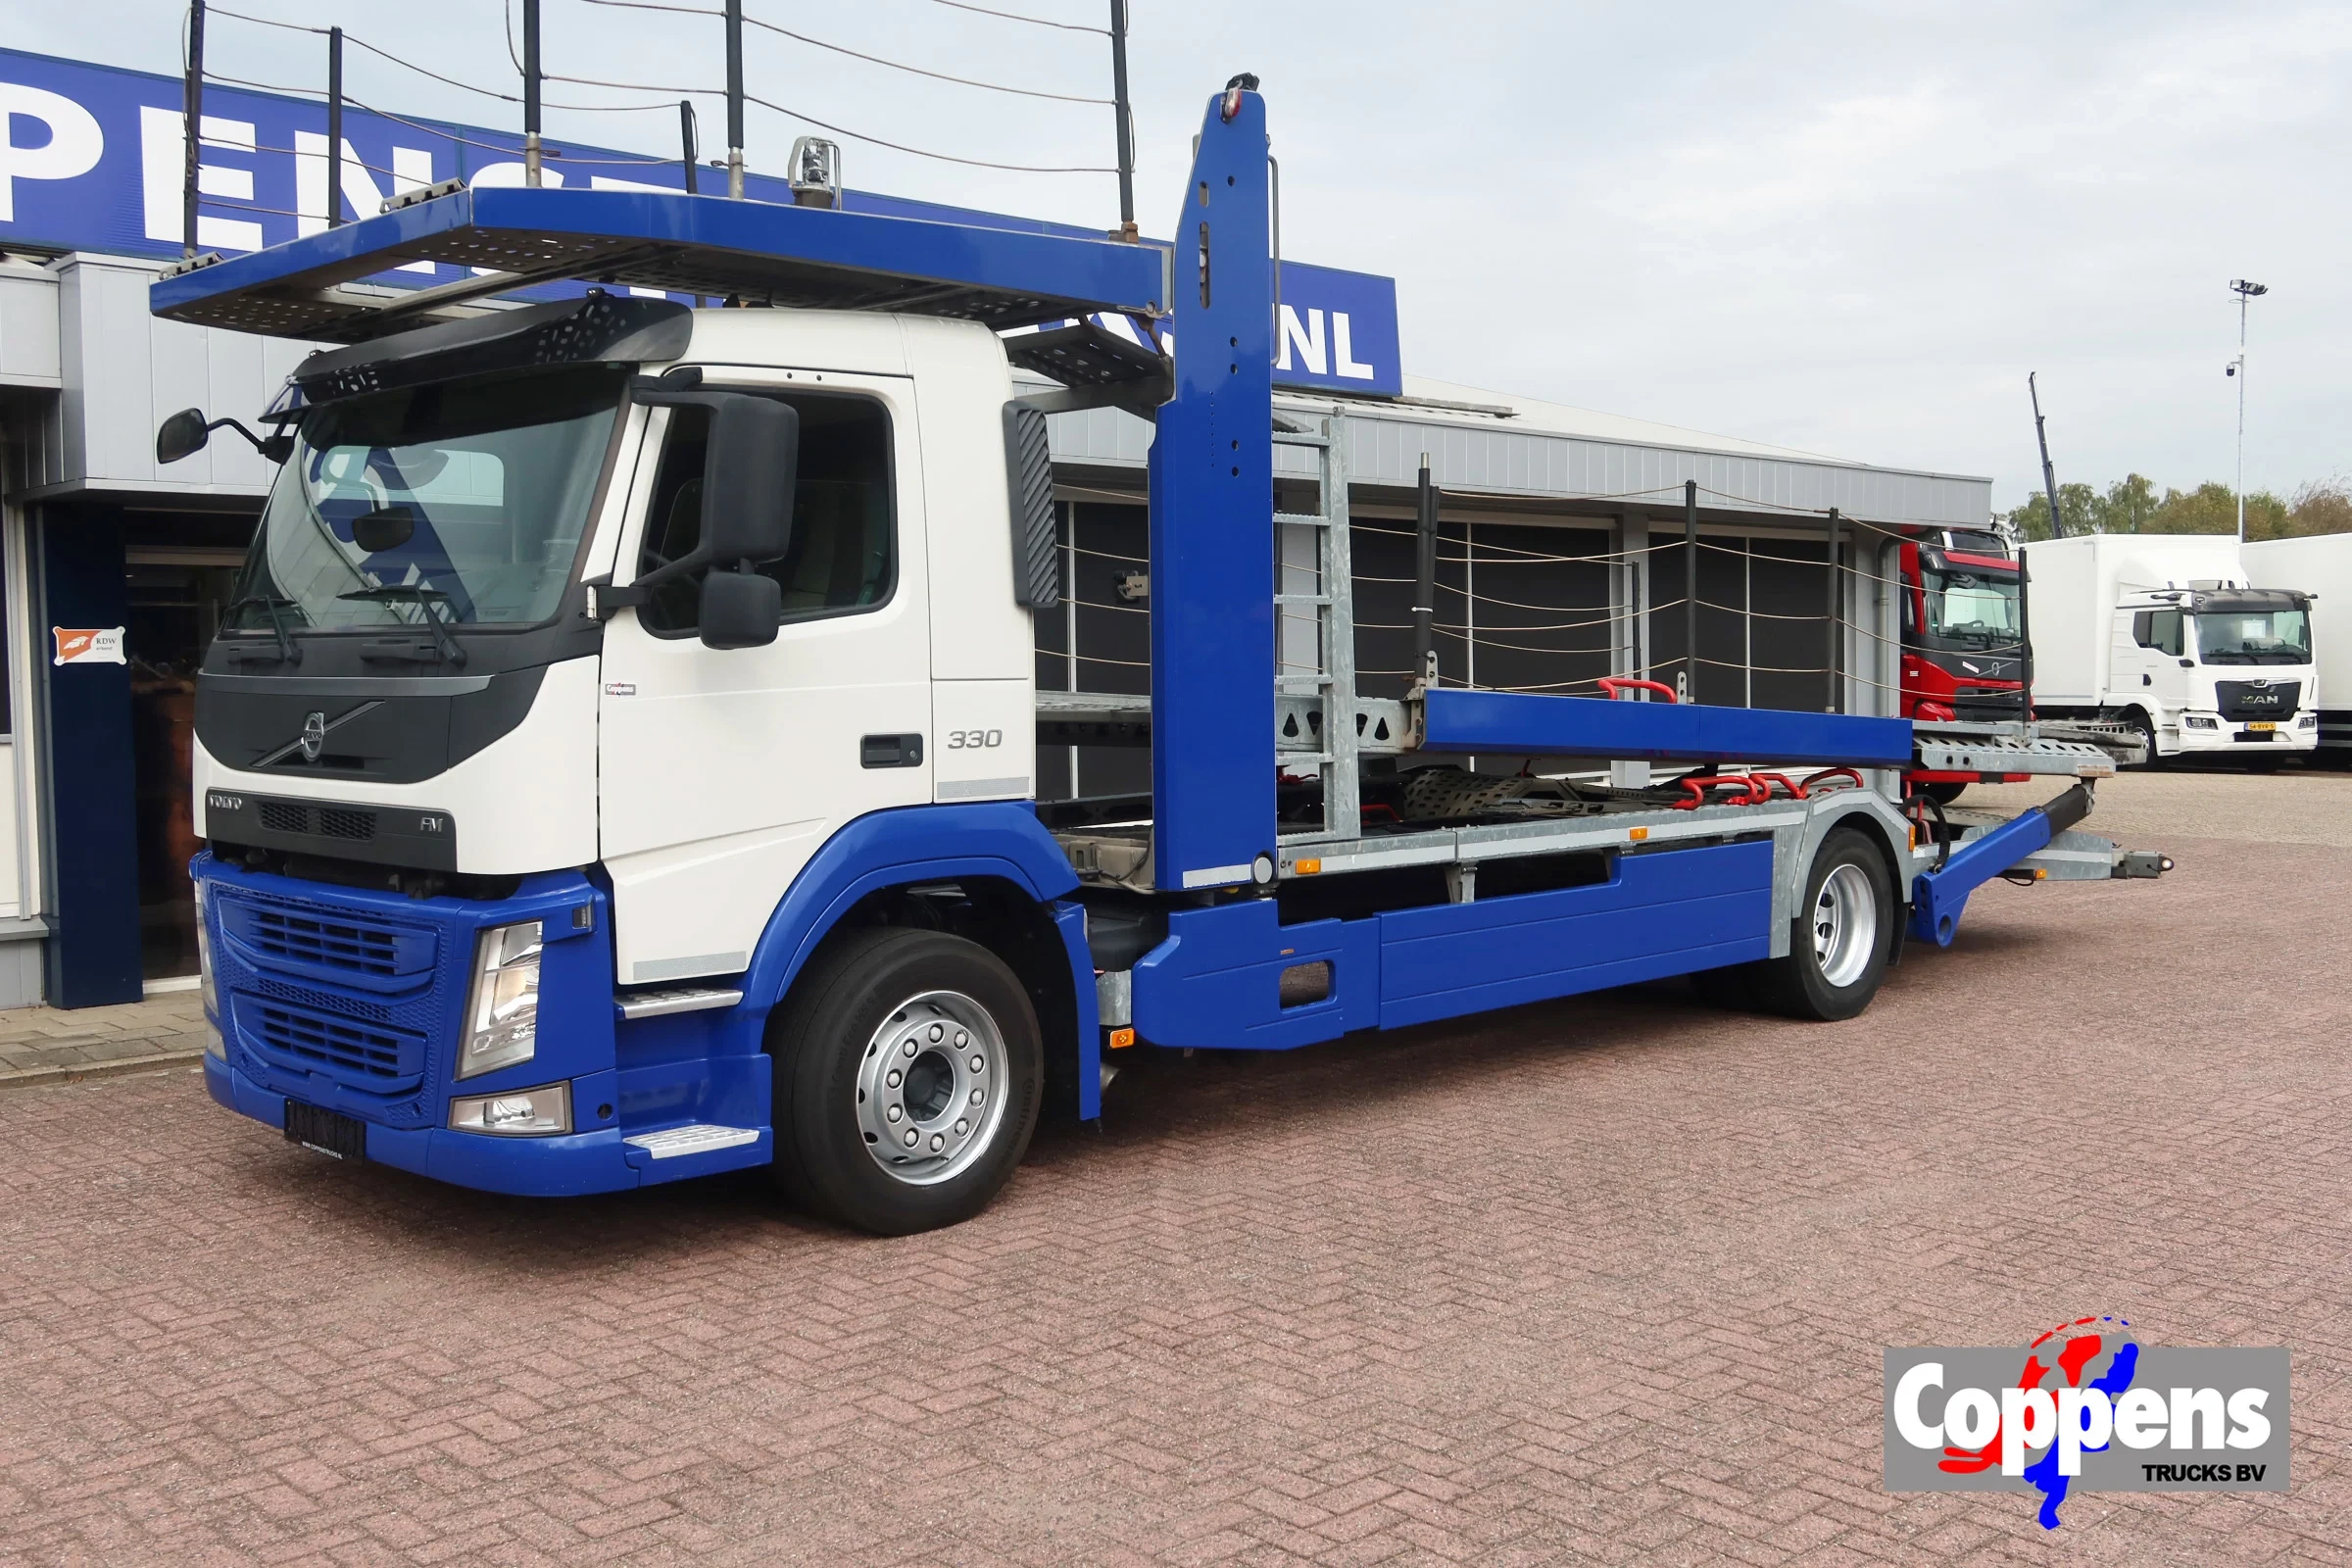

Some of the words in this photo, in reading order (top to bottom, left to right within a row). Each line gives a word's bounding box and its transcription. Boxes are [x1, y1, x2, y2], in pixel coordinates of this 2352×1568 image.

[2241, 695, 2278, 705] MAN
[948, 729, 1003, 749] 330
[210, 794, 243, 809] VOLVO
[419, 816, 443, 833] FM
